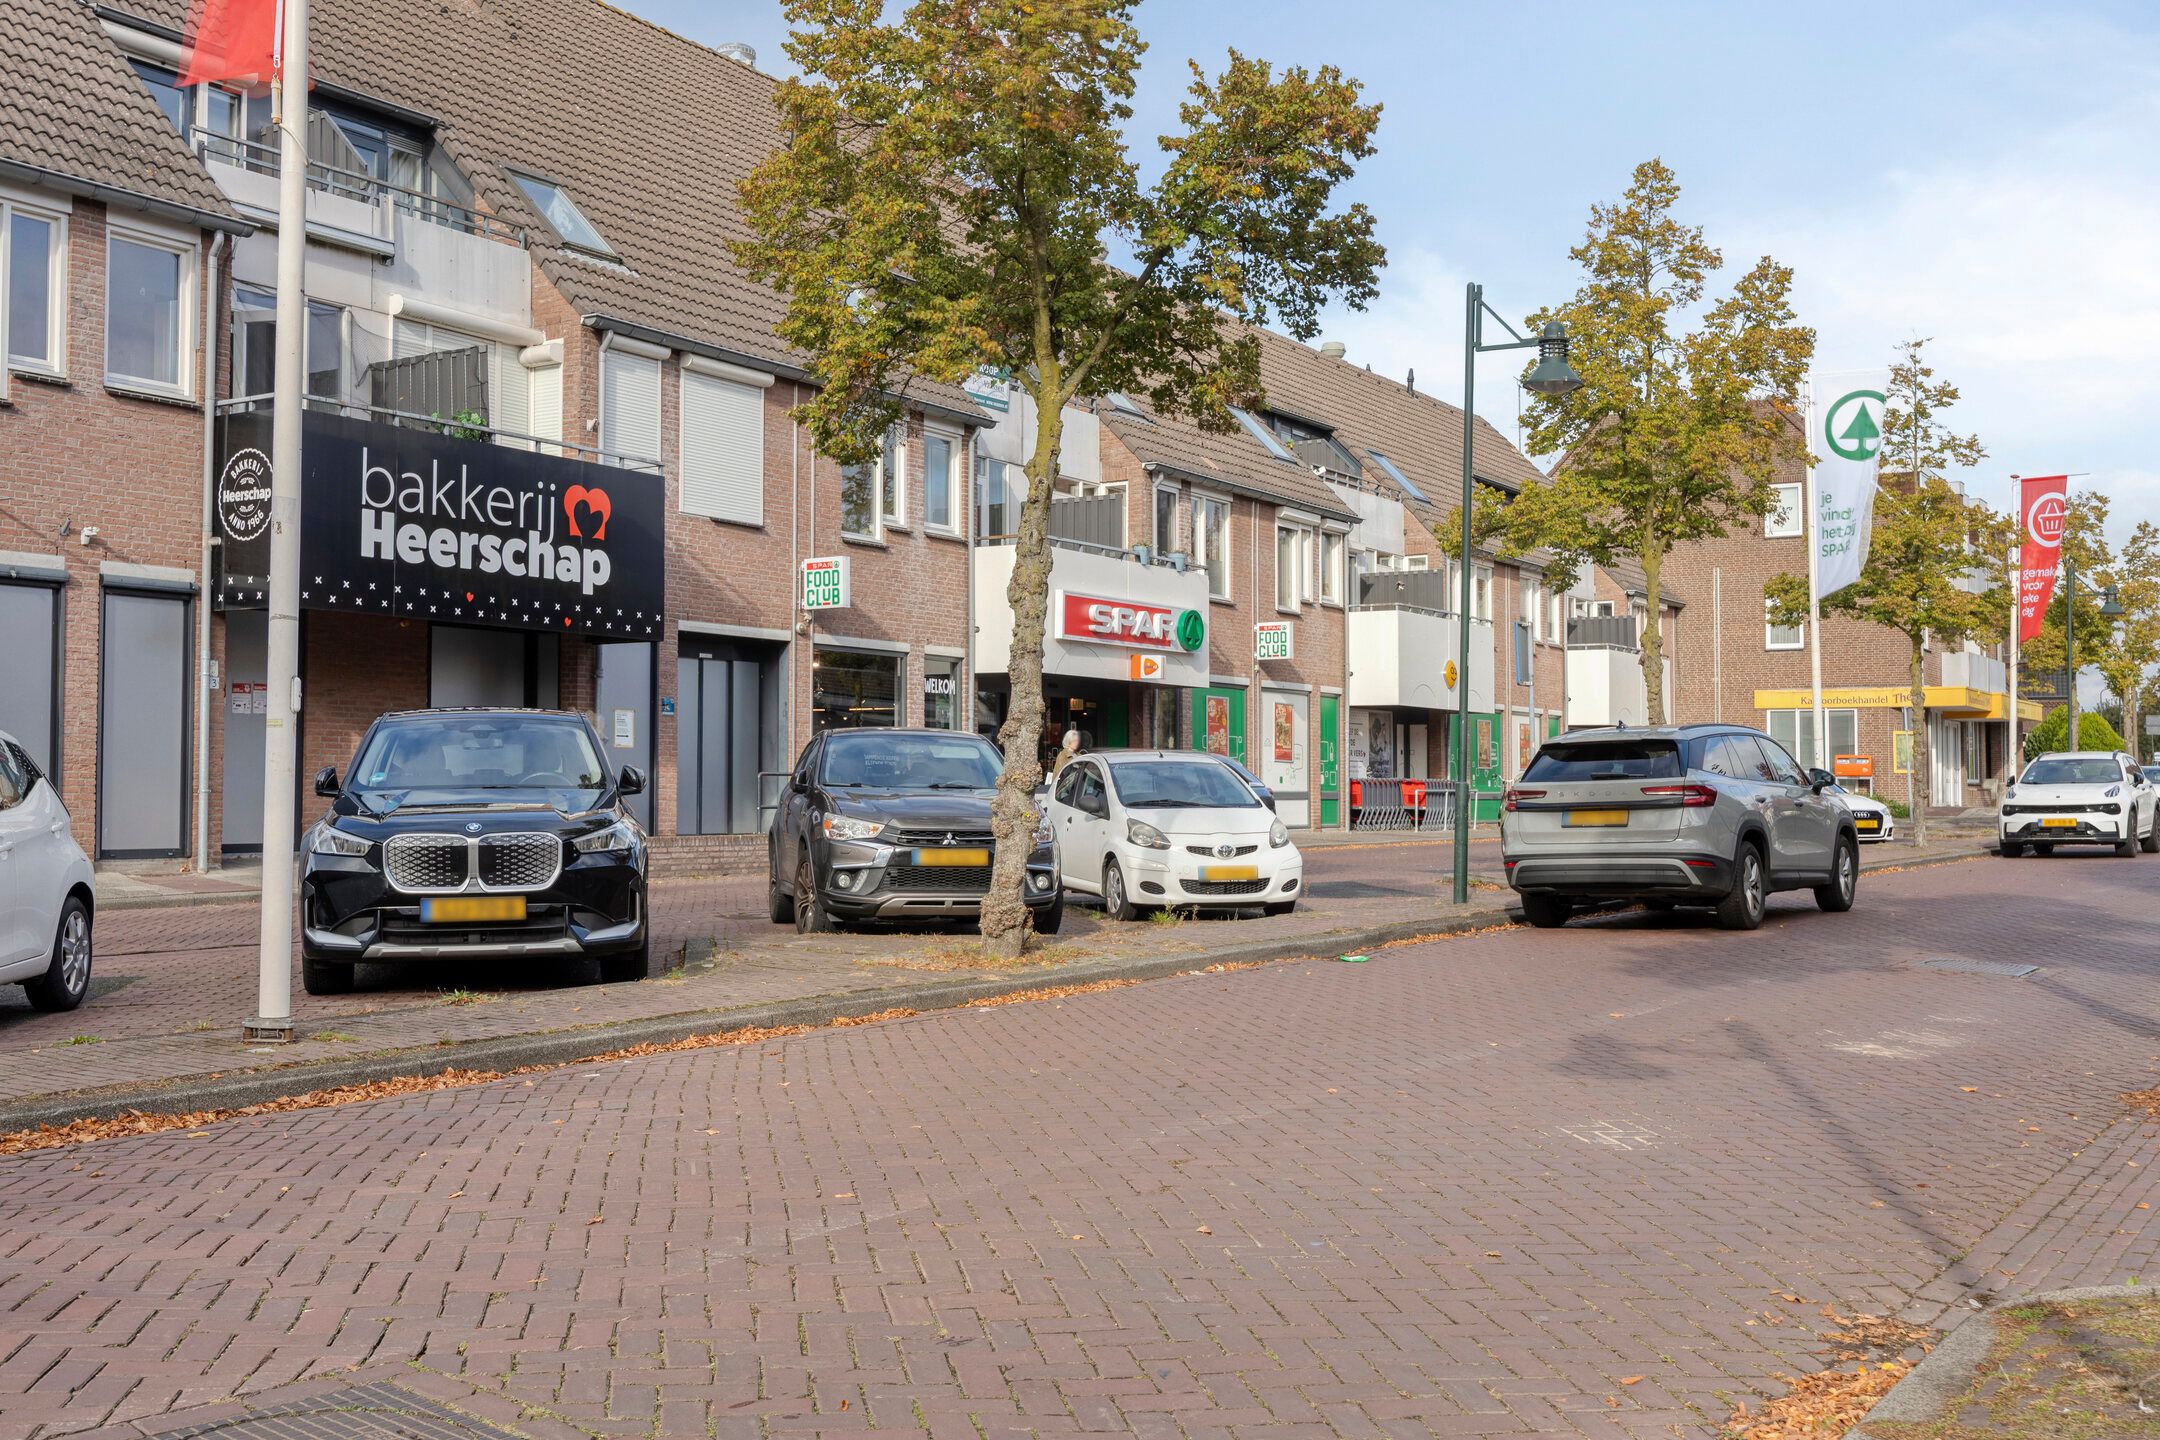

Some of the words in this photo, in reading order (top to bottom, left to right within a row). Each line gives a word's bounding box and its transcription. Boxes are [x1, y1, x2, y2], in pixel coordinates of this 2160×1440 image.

[230, 459, 264, 479] BAKKERIJ
[222, 487, 272, 503] Heerschap
[361, 447, 556, 544] bakkerij
[1820, 491, 1832, 507] je
[228, 512, 246, 531] ANNO
[247, 509, 264, 530] 1966
[361, 508, 611, 595] Heerschap
[812, 561, 833, 569] SPAR
[2023, 565, 2055, 580] gemak
[806, 569, 840, 588] FOOD
[806, 588, 840, 607] CLUB
[1088, 604, 1177, 641] SPAR
[1259, 631, 1287, 644] FOOD
[1259, 644, 1287, 657] CLUB
[212, 678, 217, 688] 3
[924, 677, 956, 695] WELKOM
[1800, 695, 1888, 705] Kaoorboekhandel
